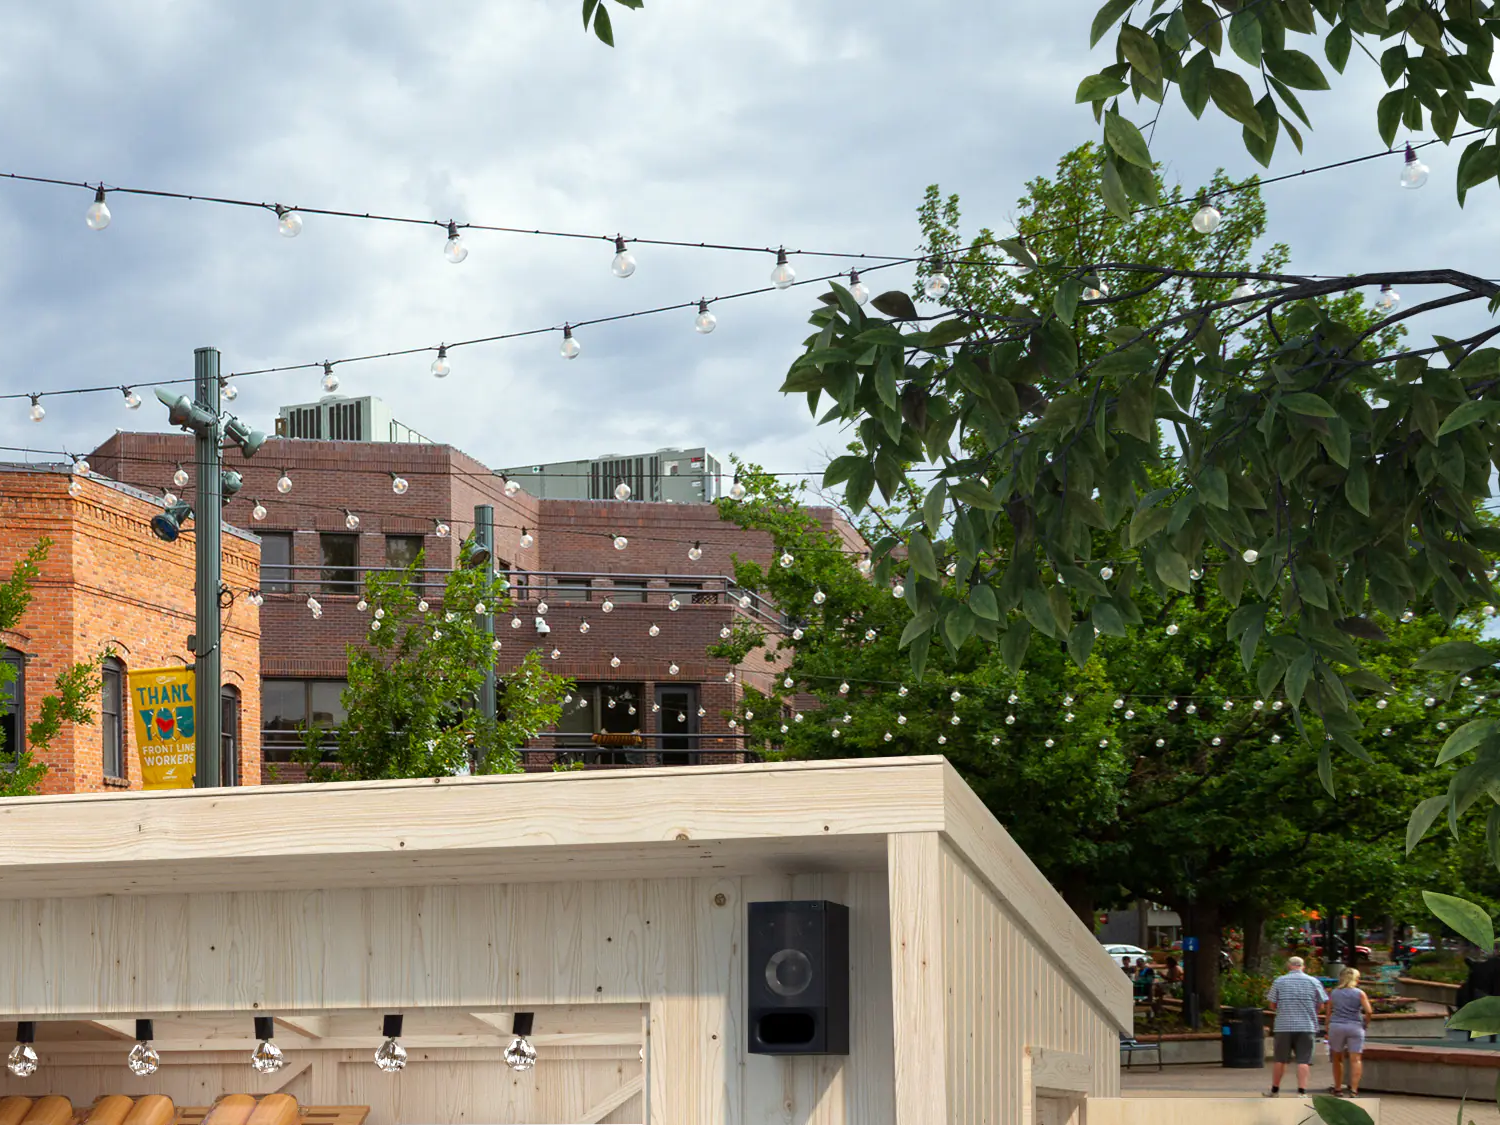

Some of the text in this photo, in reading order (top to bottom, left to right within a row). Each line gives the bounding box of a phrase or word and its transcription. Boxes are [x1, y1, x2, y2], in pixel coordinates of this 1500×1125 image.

[136, 683, 192, 706] THANK
[139, 706, 195, 741] YOU
[142, 742, 195, 755] FRONT LINE
[144, 754, 194, 766] WORKERS
